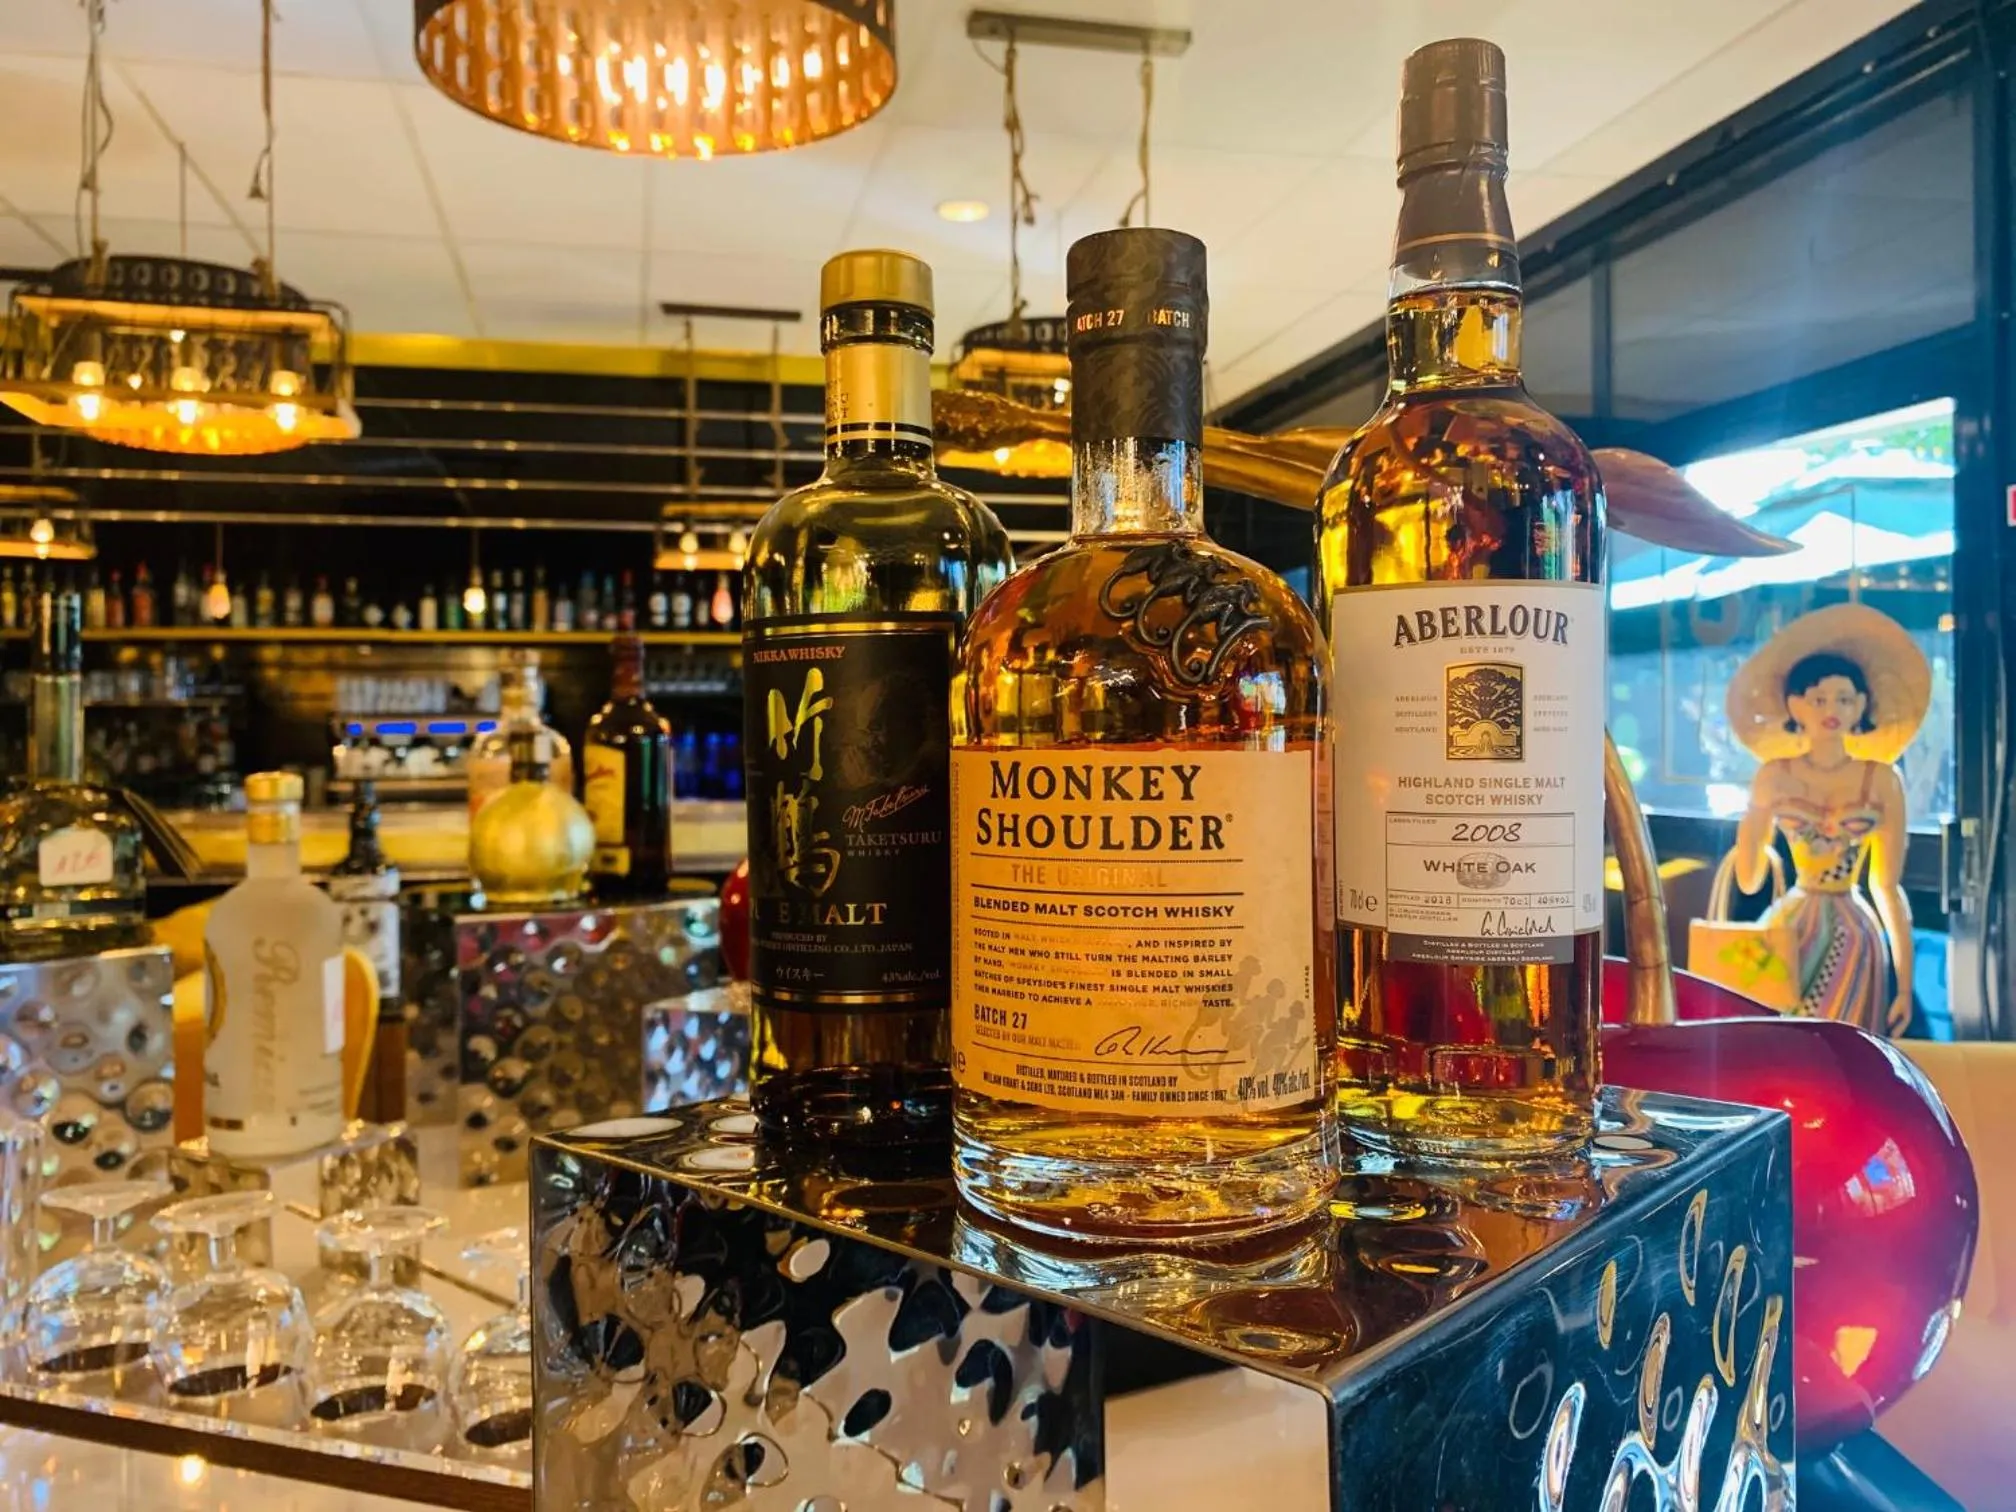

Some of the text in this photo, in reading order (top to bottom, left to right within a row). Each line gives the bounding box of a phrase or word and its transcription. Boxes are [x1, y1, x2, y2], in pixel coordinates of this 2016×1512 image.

[1107, 309, 1125, 327] 27
[1394, 604, 1568, 647] ABERLOUR
[786, 647, 845, 660] WHISKY
[990, 760, 1201, 801] MONKEY
[1399, 776, 1566, 789] HIGHLAND SINGLE MALT
[1425, 794, 1543, 806] SCOTCH WHISKY
[845, 831, 942, 847] TAKETSURU
[1451, 822, 1522, 843] 2008
[847, 848, 900, 857] WHISKY
[1011, 864, 1046, 884] THE
[1423, 859, 1537, 874] WHITE OAK
[974, 896, 1234, 918] BLENDED MALT SCOTCH WHISKY
[974, 927, 1000, 938] ROOTED
[1002, 931, 1010, 940] IN
[975, 942, 1233, 964] THE MALT MEN WHO STILL TURN THE MALTING BARLEY
[1136, 940, 1160, 949] AND
[1164, 939, 1215, 949] INSPIRED
[1219, 939, 1233, 947] BY
[776, 965, 826, 981] ウイスキー
[974, 969, 1002, 981] BATCHES
[1003, 975, 1014, 983] OF
[1069, 981, 1105, 992] FINEST
[1109, 984, 1148, 993] SINGLE
[1152, 985, 1180, 993] MALT
[1184, 983, 1233, 993] WHISKIES
[1111, 970, 1122, 978] IS
[1126, 970, 1178, 978] BLENDED
[1183, 970, 1194, 978] IN
[1199, 969, 1233, 978] SMALL
[991, 988, 1026, 1000] MARRIED
[1028, 993, 1040, 1002] TO
[1041, 995, 1082, 1006] ACHIEVE
[1085, 997, 1092, 1006] A
[1202, 998, 1234, 1008] TASTE.
[974, 1003, 1028, 1030] BATCH 27
[1012, 1032, 1026, 1044] OUR
[1047, 1068, 1077, 1083] MATURED
[1079, 1072, 1085, 1083] &
[1087, 1072, 1117, 1086] BOTTLED
[1120, 1074, 1126, 1086] IN
[1129, 1075, 1166, 1087] SCOTLAND
[1168, 1075, 1178, 1087] BY
[1058, 1085, 1092, 1099] SCOTLAND
[1132, 1091, 1157, 1103] FAMILY
[1160, 1091, 1186, 1103] OWNED
[1188, 1090, 1208, 1102] SINCE
[1237, 1076, 1255, 1101] 40%
